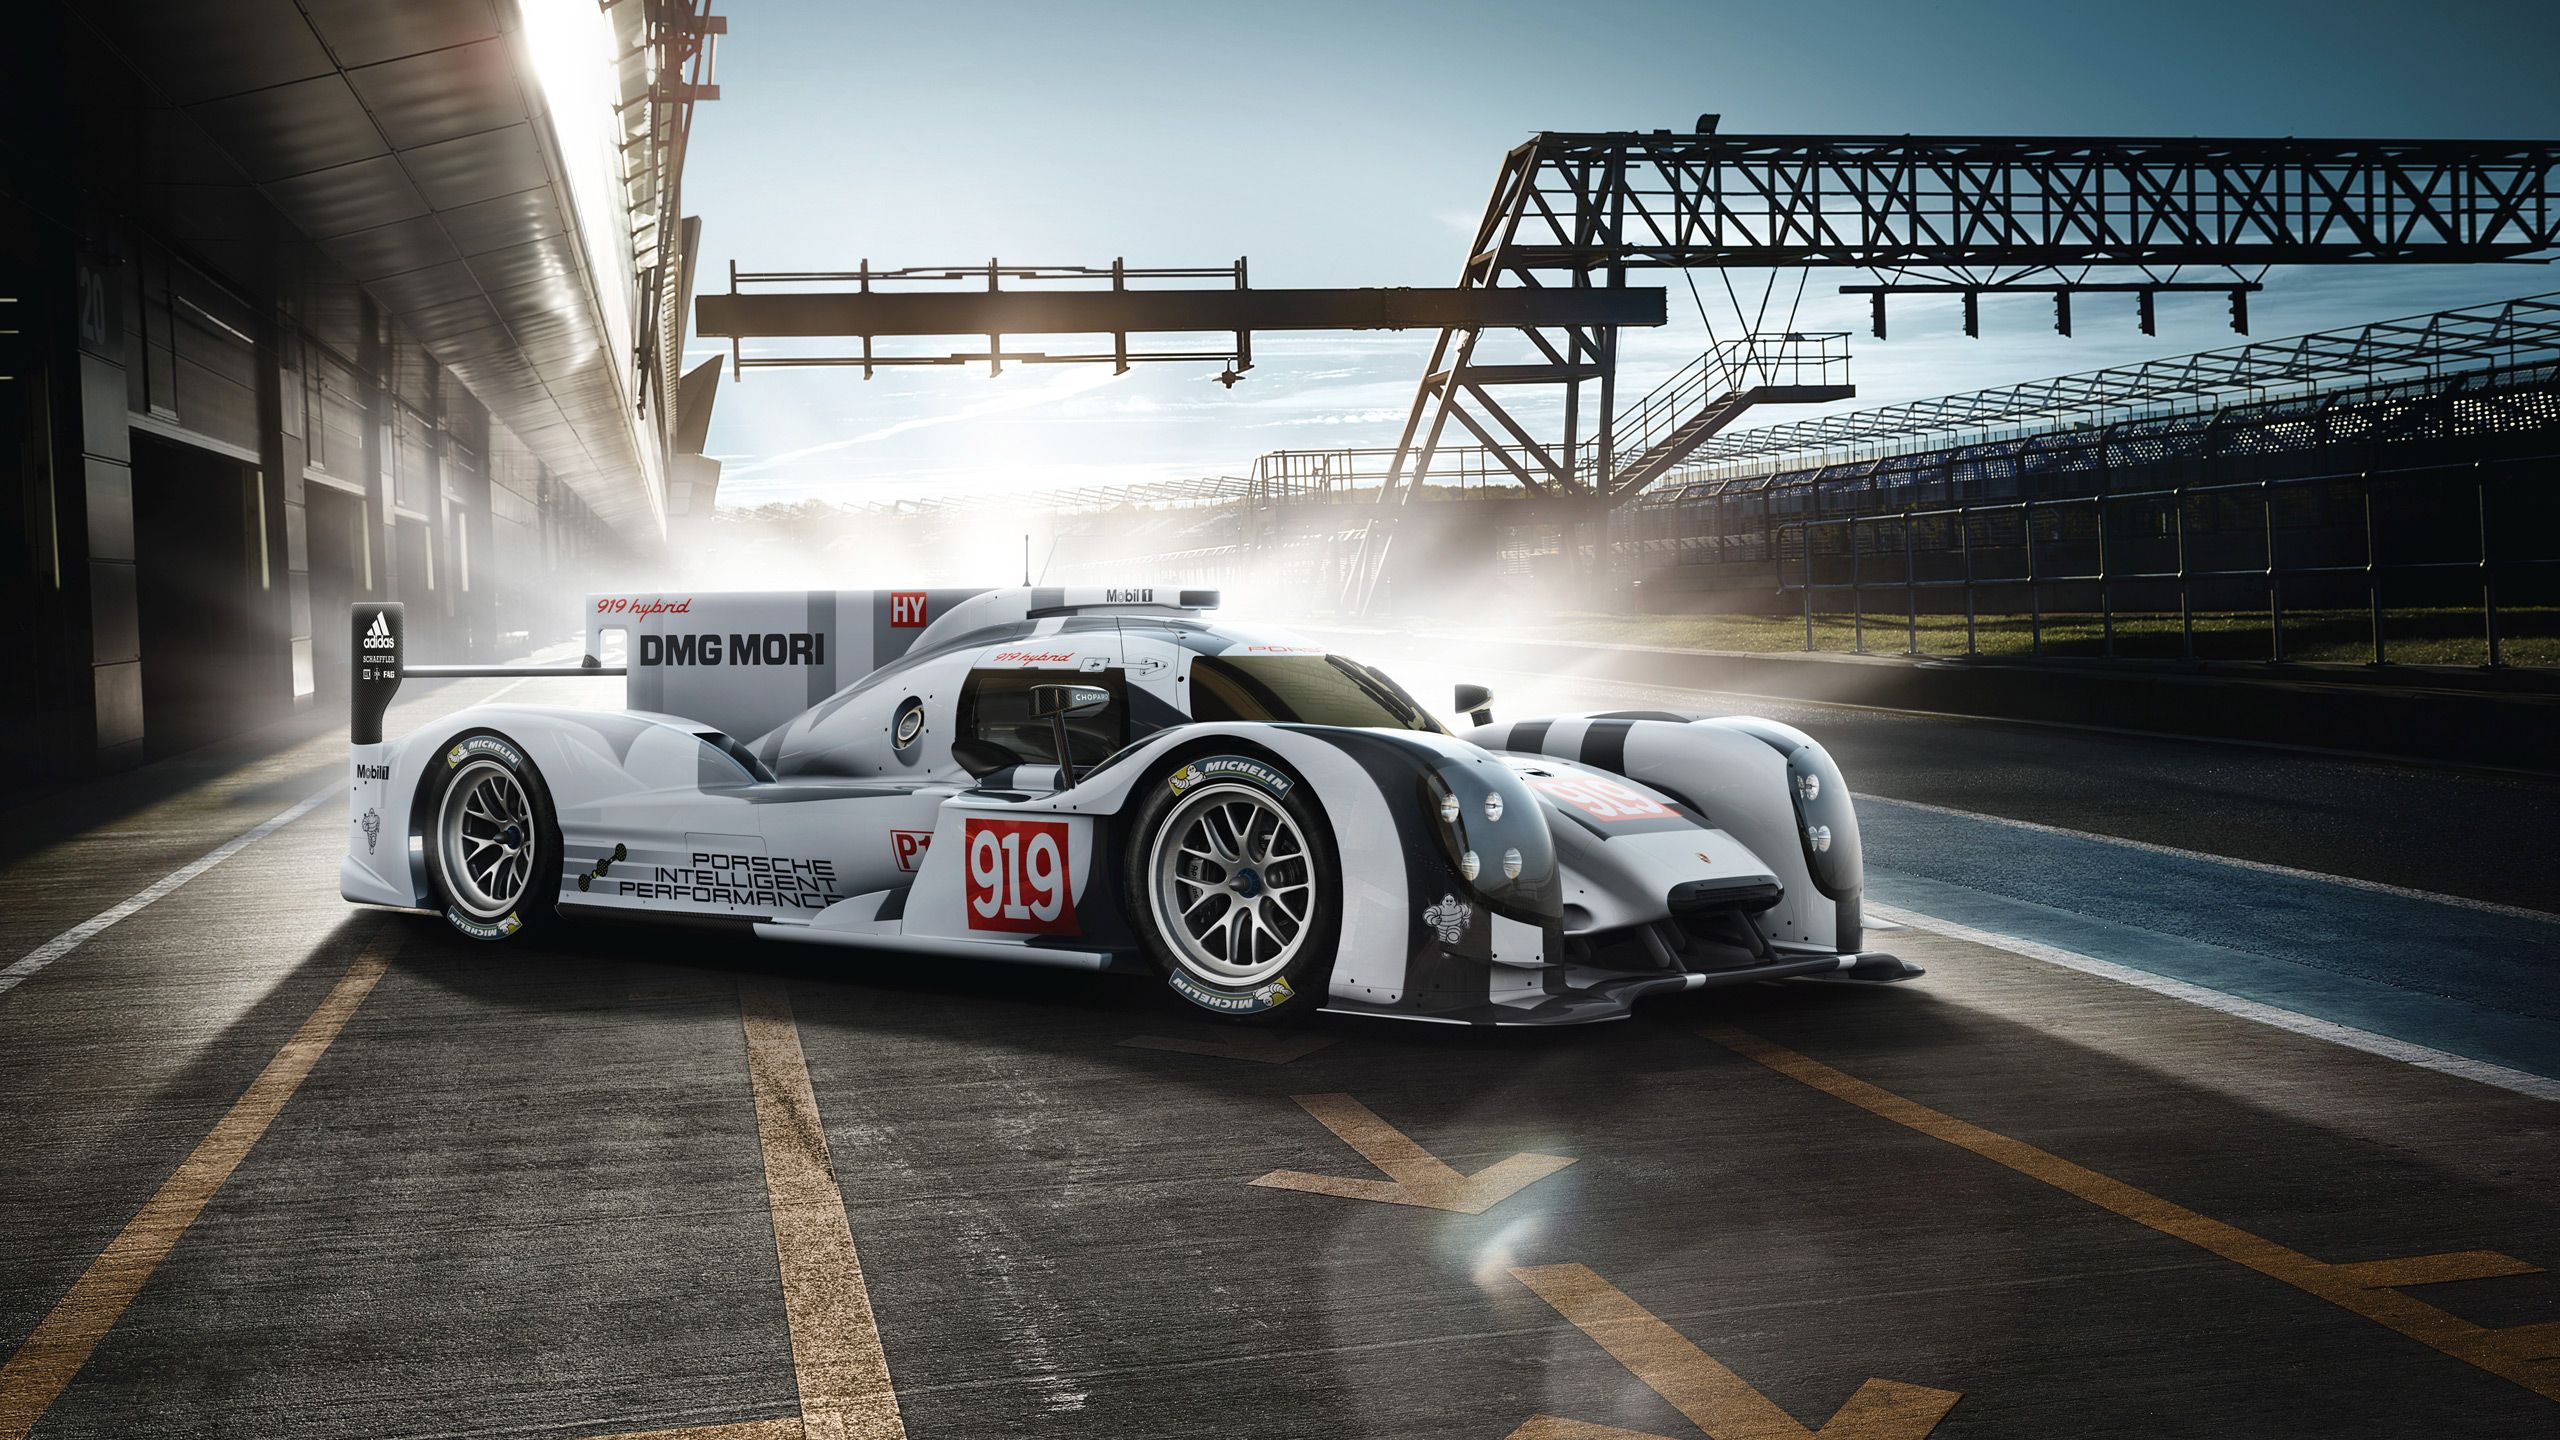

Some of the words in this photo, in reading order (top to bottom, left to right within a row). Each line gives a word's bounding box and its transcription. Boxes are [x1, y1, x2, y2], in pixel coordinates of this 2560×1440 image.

[79, 265, 106, 345] 20
[1106, 588, 1139, 603] Mobil
[597, 598, 627, 614] 919
[627, 598, 692, 623] hybrid
[893, 596, 925, 623] HY
[363, 634, 395, 649] adidas
[639, 634, 723, 666] DMG
[729, 632, 825, 666] MORI
[362, 655, 395, 664] SCHAEFFLER
[993, 652, 1022, 662] 919
[1018, 651, 1076, 667] hybrid
[383, 670, 395, 679] FAG
[468, 740, 519, 764] MICHELIN
[356, 764, 382, 780] Mobil
[1204, 760, 1288, 791] MICHELIN
[1537, 780, 1664, 817] 919
[692, 852, 835, 876] PORSCHE
[970, 829, 1064, 922] 919
[655, 866, 837, 893] INTELLIGENT
[448, 912, 497, 937] MICHELIN
[1172, 977, 1254, 1009] MICHELIN
